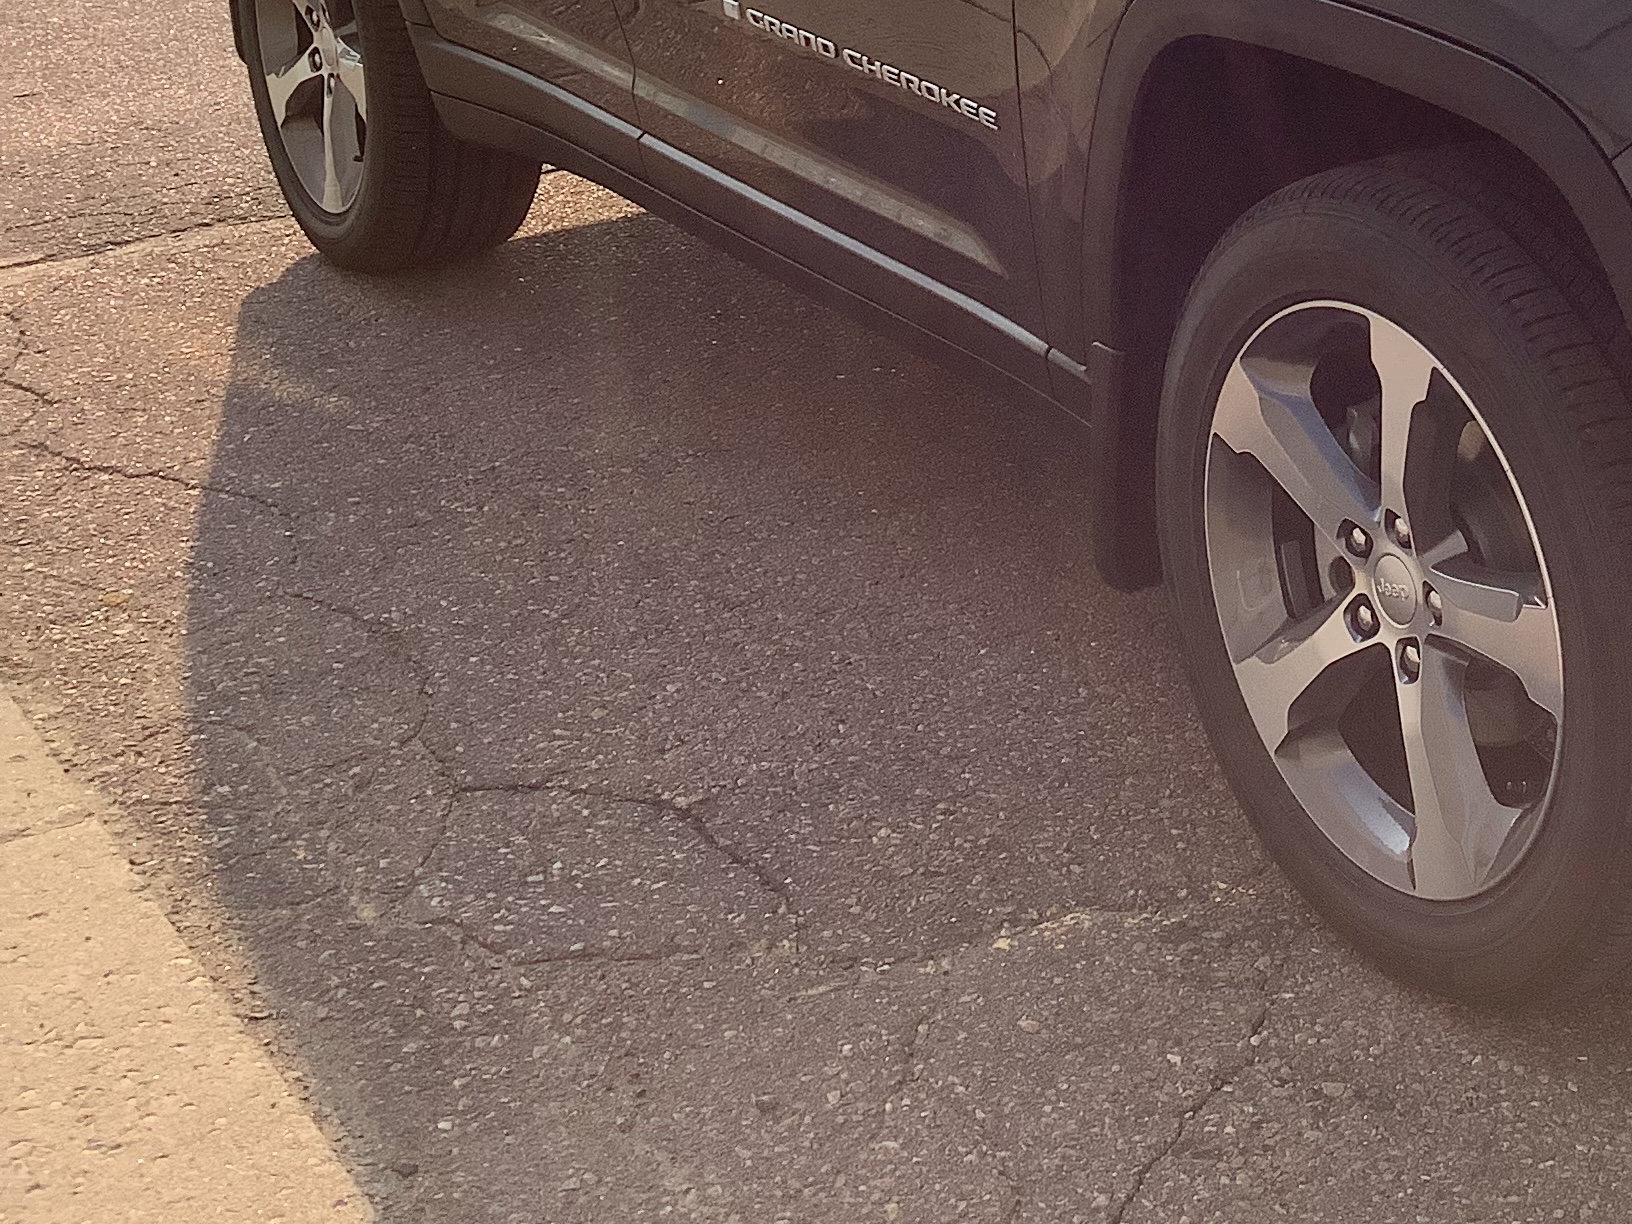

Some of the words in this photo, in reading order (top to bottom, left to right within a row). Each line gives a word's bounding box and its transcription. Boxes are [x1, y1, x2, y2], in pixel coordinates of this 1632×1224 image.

[746, 8, 838, 59] GRAND
[843, 48, 1000, 131] CHEROKEE
[1377, 577, 1410, 601] Jeep
